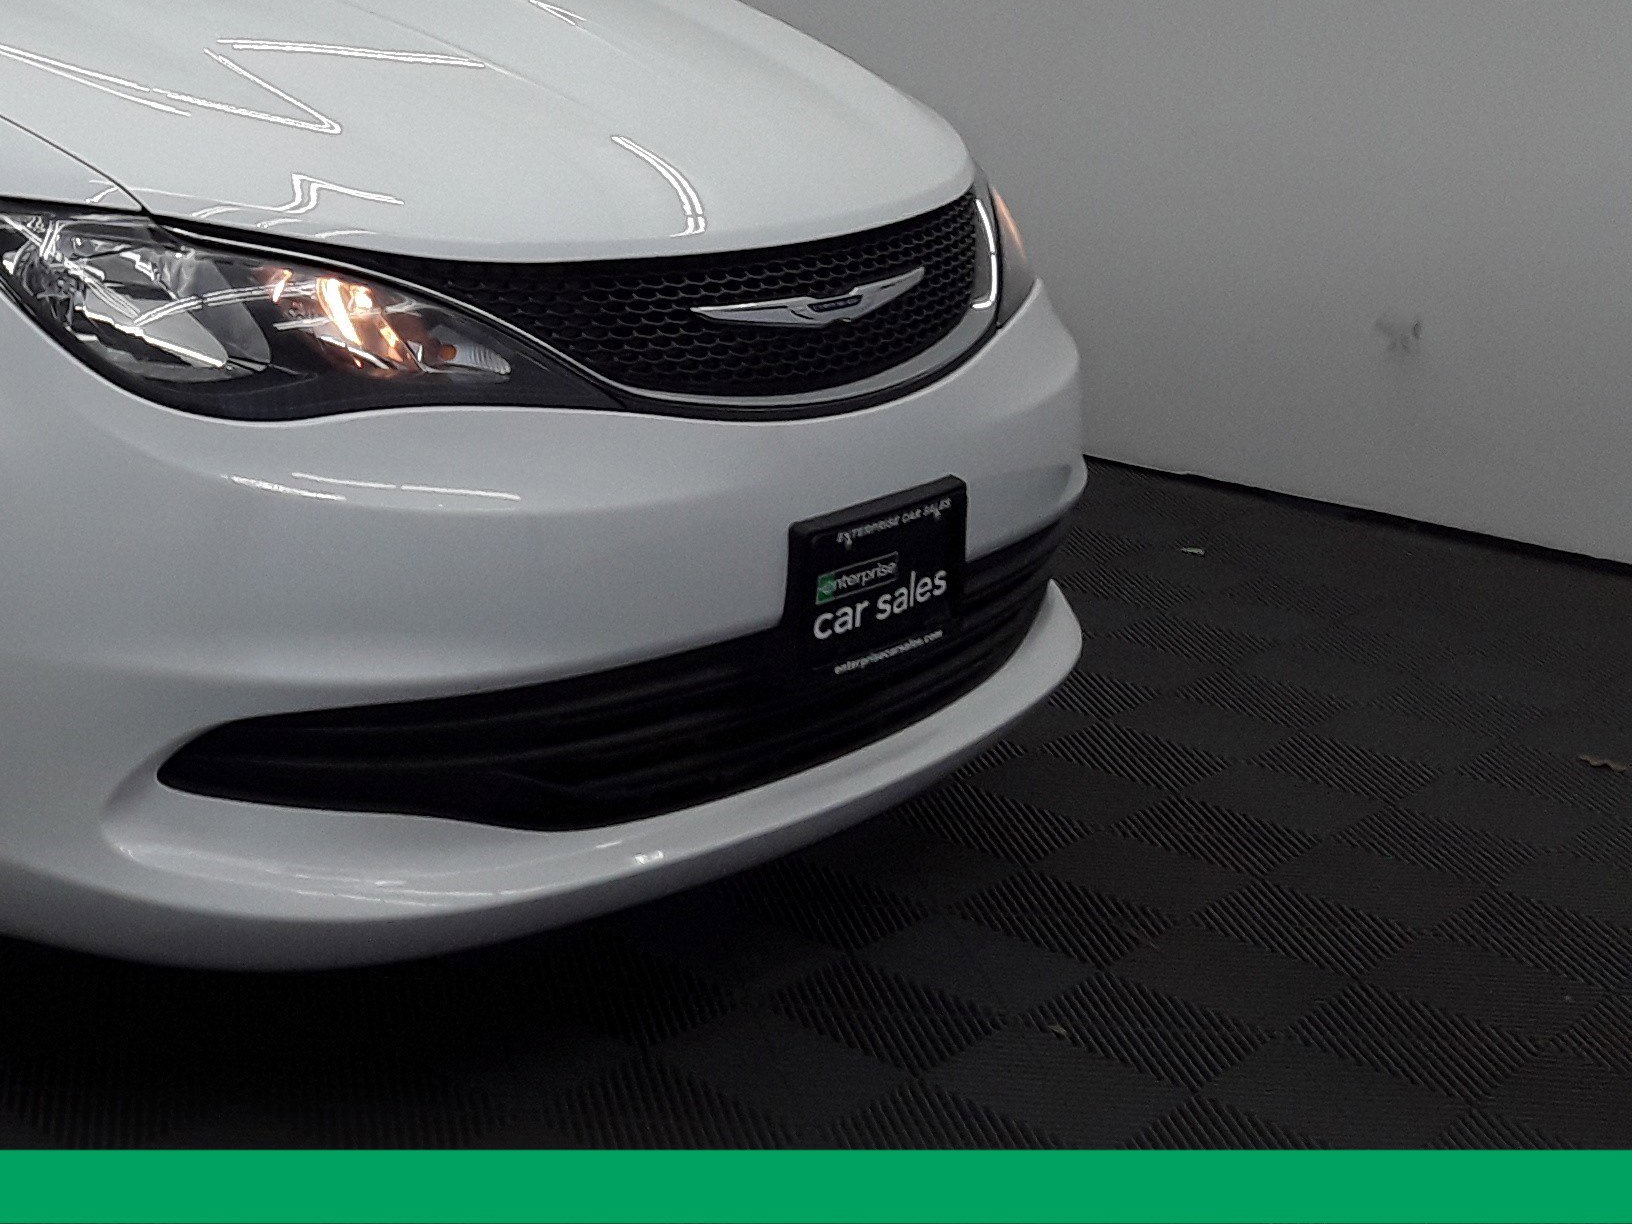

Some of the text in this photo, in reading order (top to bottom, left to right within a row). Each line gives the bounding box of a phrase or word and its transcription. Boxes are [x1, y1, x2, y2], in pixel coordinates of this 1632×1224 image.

[818, 562, 899, 595] enterprise
[813, 570, 948, 640] car sales
